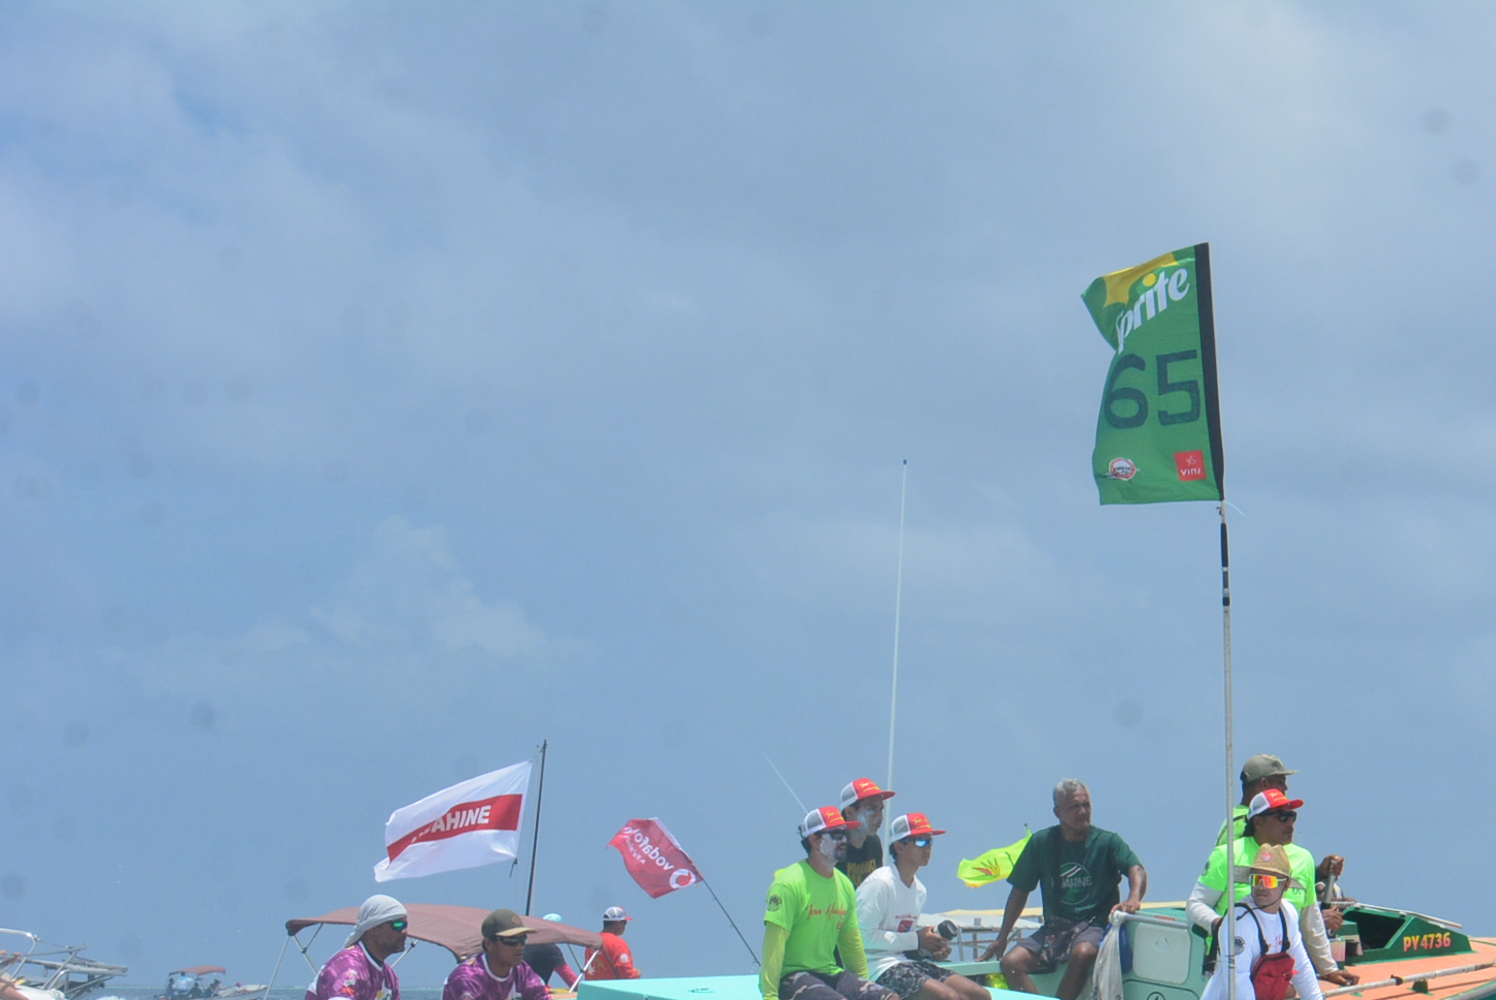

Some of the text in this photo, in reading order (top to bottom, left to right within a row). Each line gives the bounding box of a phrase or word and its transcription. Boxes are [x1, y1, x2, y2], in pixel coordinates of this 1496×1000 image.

[1115, 268, 1190, 355] prite
[1104, 350, 1201, 430] 65
[411, 804, 492, 844] AHINE
[1403, 932, 1452, 952] PY 4736
